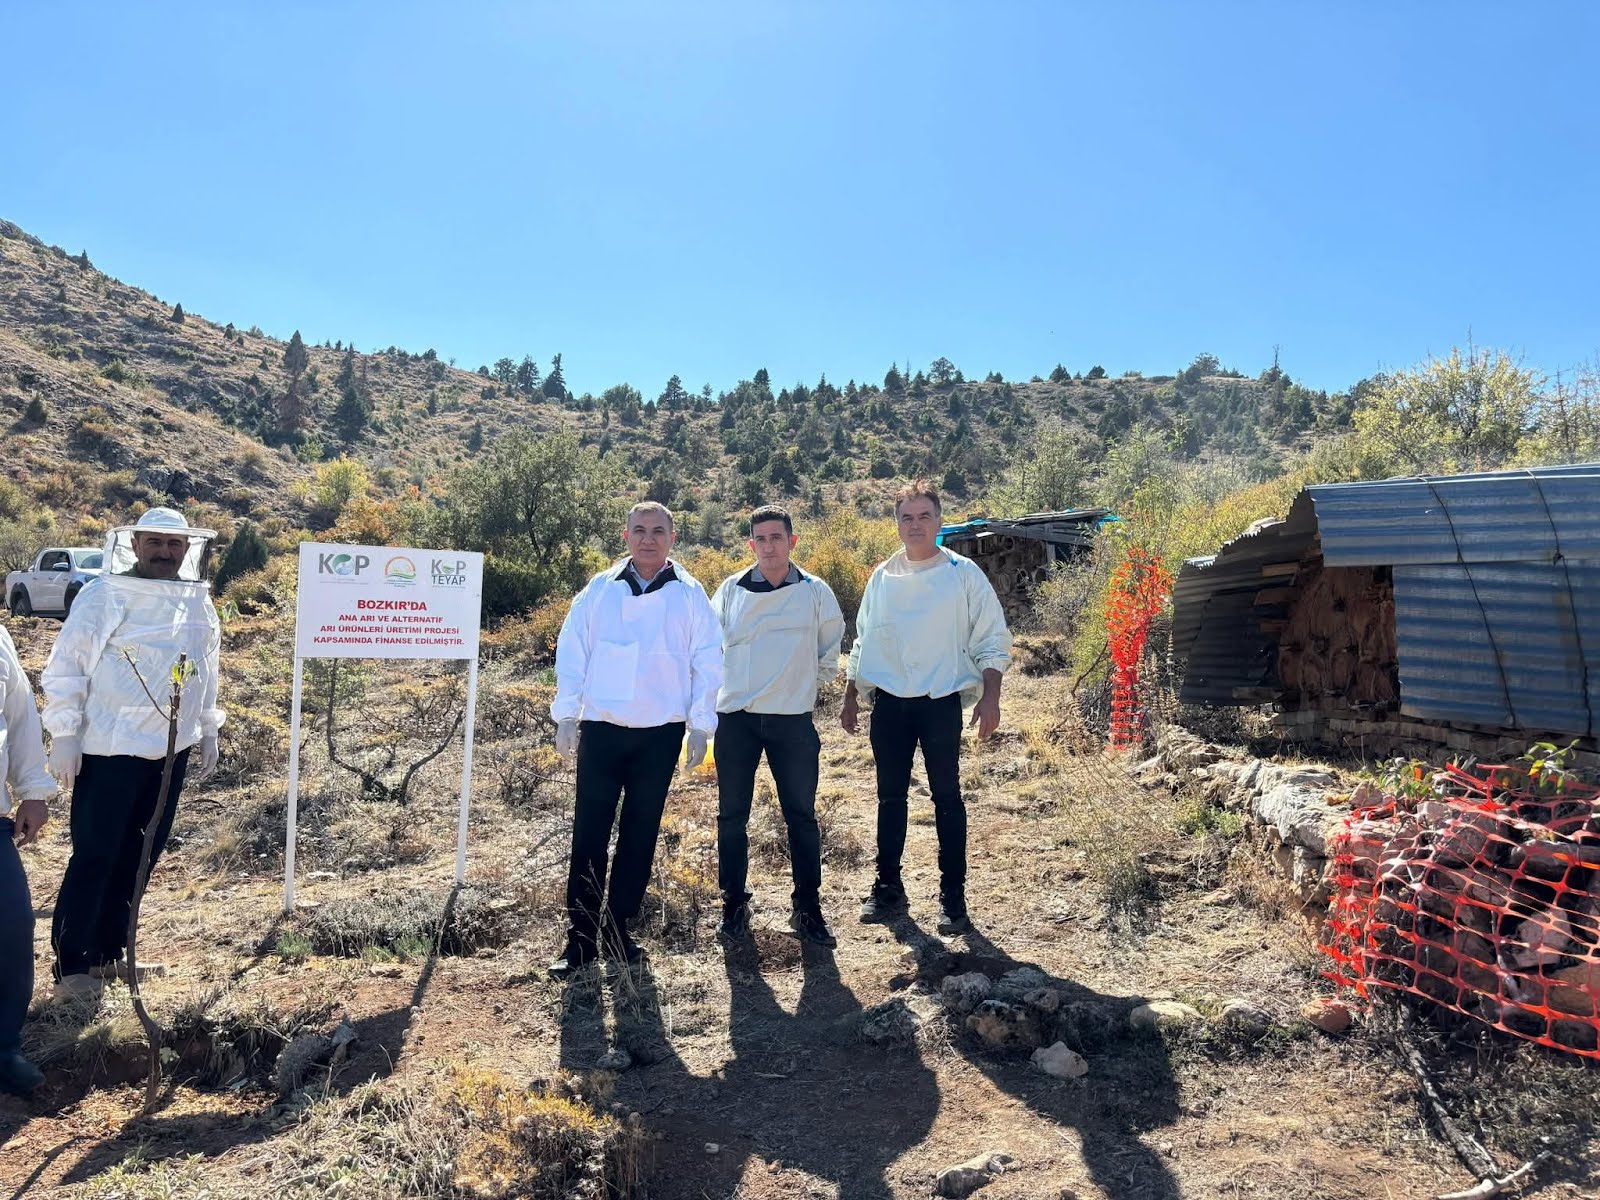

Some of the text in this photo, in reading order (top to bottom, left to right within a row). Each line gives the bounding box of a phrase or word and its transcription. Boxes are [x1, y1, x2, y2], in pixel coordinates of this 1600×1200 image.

[432, 575, 466, 586] TEYAP
[357, 599, 427, 611] BOZKIR'DA
[338, 614, 358, 622] ANA
[338, 624, 384, 633] ÜRÜNLERİ
[386, 625, 422, 634] ÜRETİMİ
[424, 626, 459, 634] PROJESİ
[314, 636, 464, 647] KAPSAMINDA FİNANSE EDİLMİŞTİR.
